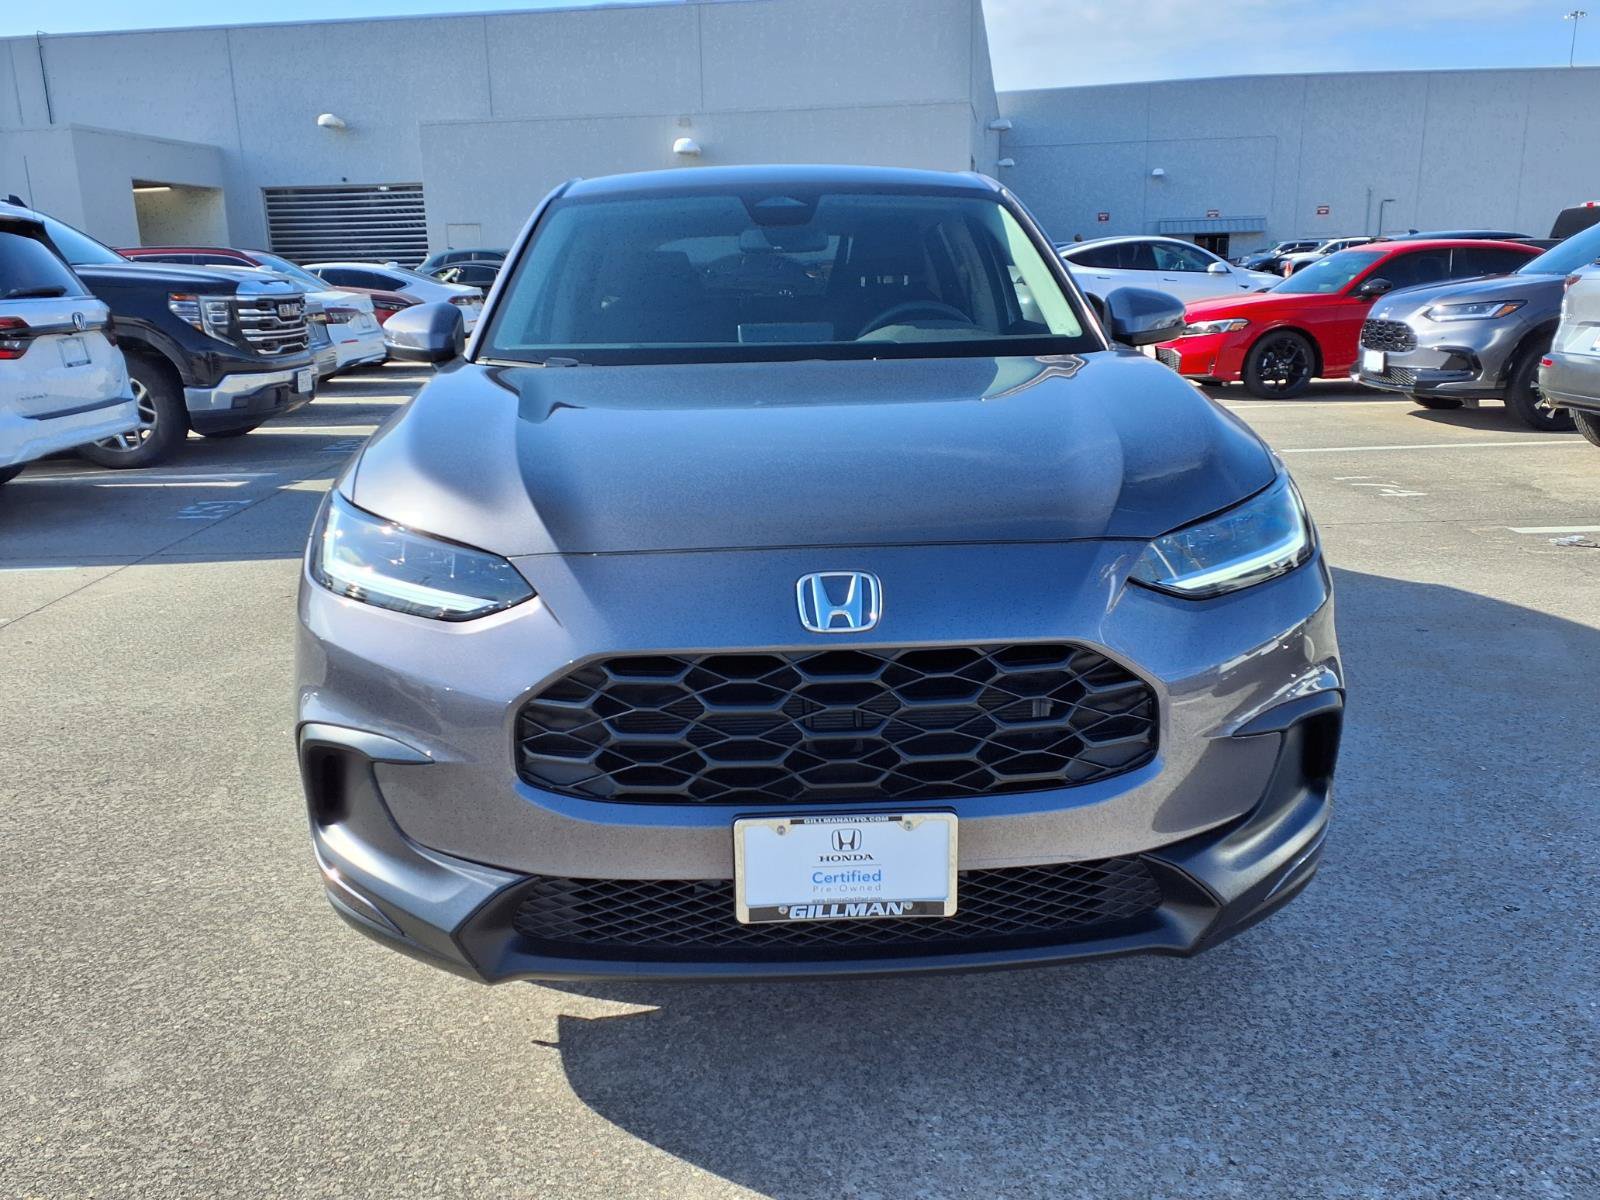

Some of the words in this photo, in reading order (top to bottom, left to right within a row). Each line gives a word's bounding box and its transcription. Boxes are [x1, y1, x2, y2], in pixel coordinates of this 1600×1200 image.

[804, 816, 889, 824] GILLMANAUTO.COM
[819, 853, 874, 862] HONDA
[812, 869, 882, 883] Certified
[812, 884, 882, 892] Pre-Owned
[789, 902, 904, 919] GILLMAN
